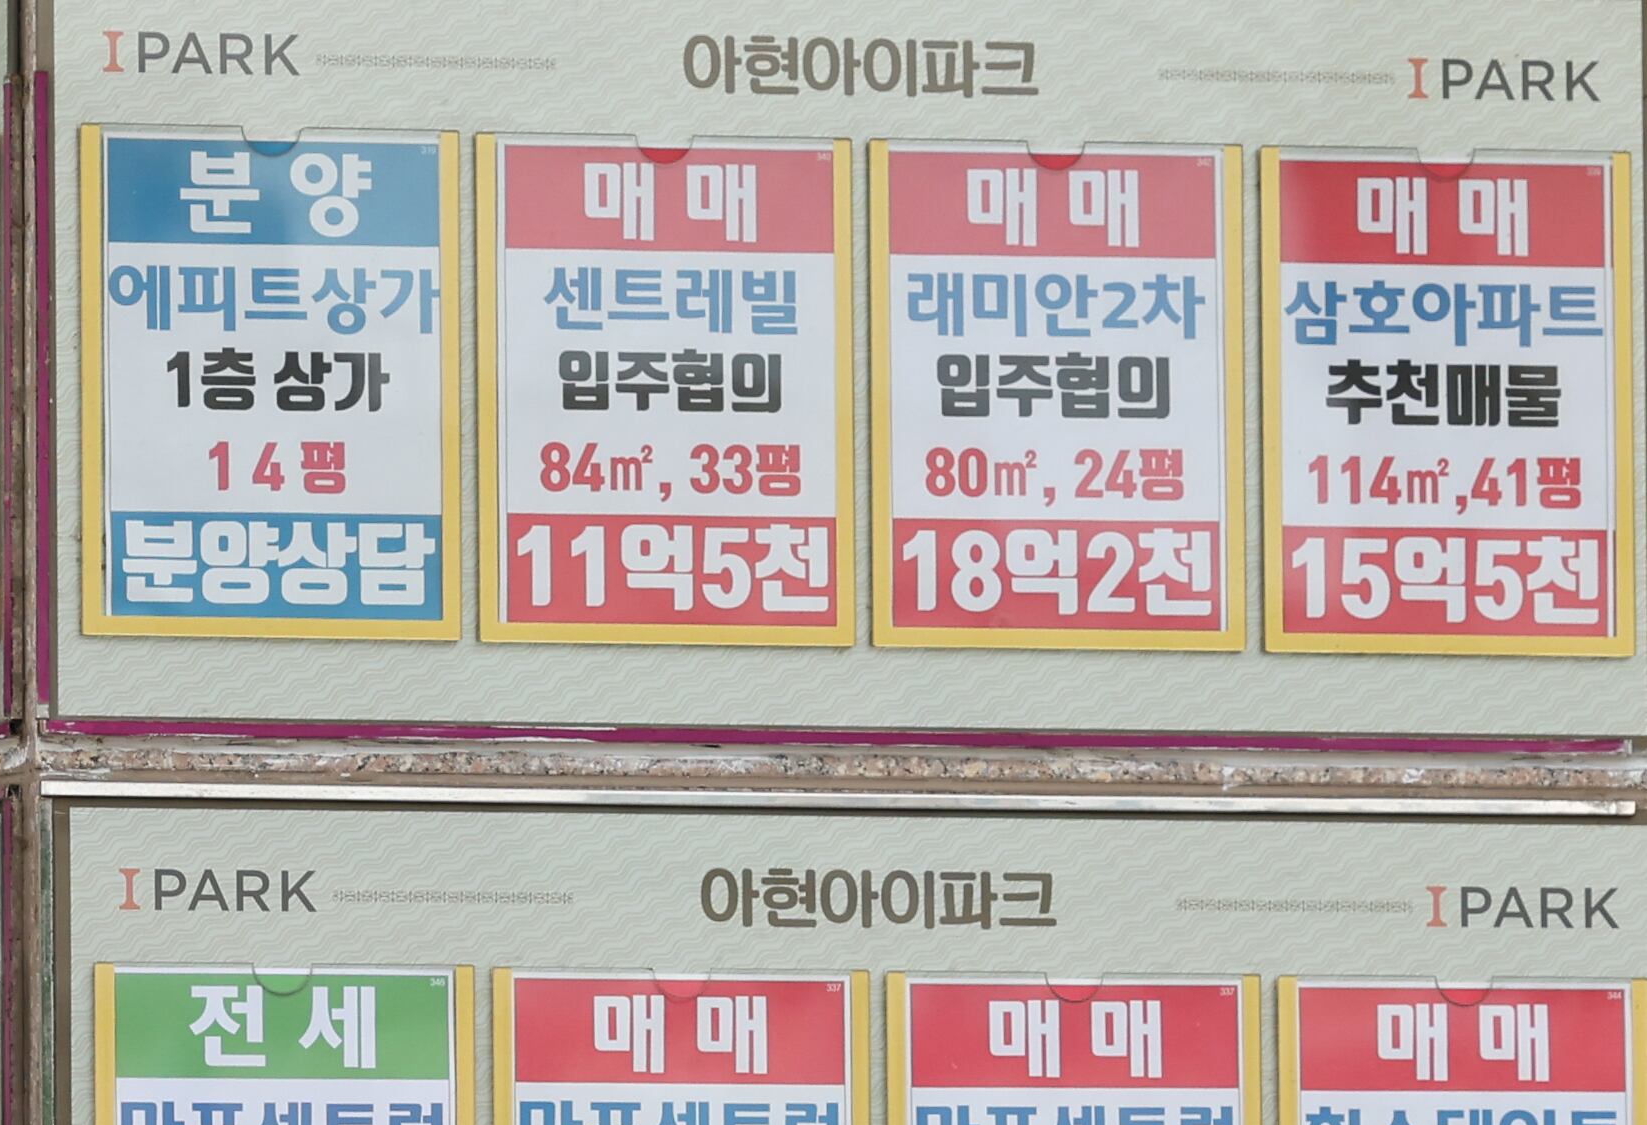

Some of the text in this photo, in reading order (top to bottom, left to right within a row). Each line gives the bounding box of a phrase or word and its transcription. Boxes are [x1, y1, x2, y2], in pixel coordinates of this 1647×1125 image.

[684, 35, 1039, 98] 아현아이파크
[108, 265, 441, 334] 에피트상가
[544, 267, 797, 335] 센트레빌
[908, 273, 1205, 339] 래미안2차
[1285, 280, 1603, 347] 삼호아파트
[167, 348, 389, 412] 1층 상가
[559, 349, 781, 413] 입주협의
[937, 352, 1170, 419] 입주협의
[1327, 359, 1561, 427] 추천매물
[690, 444, 801, 496] 33평
[1075, 449, 1183, 500] 24평
[123, 520, 435, 605] 분양상담
[518, 524, 828, 611] 11억5천
[903, 528, 1211, 615] 18억2천
[1292, 536, 1599, 624] 15억5천
[701, 868, 1057, 929] 아현아이파크
